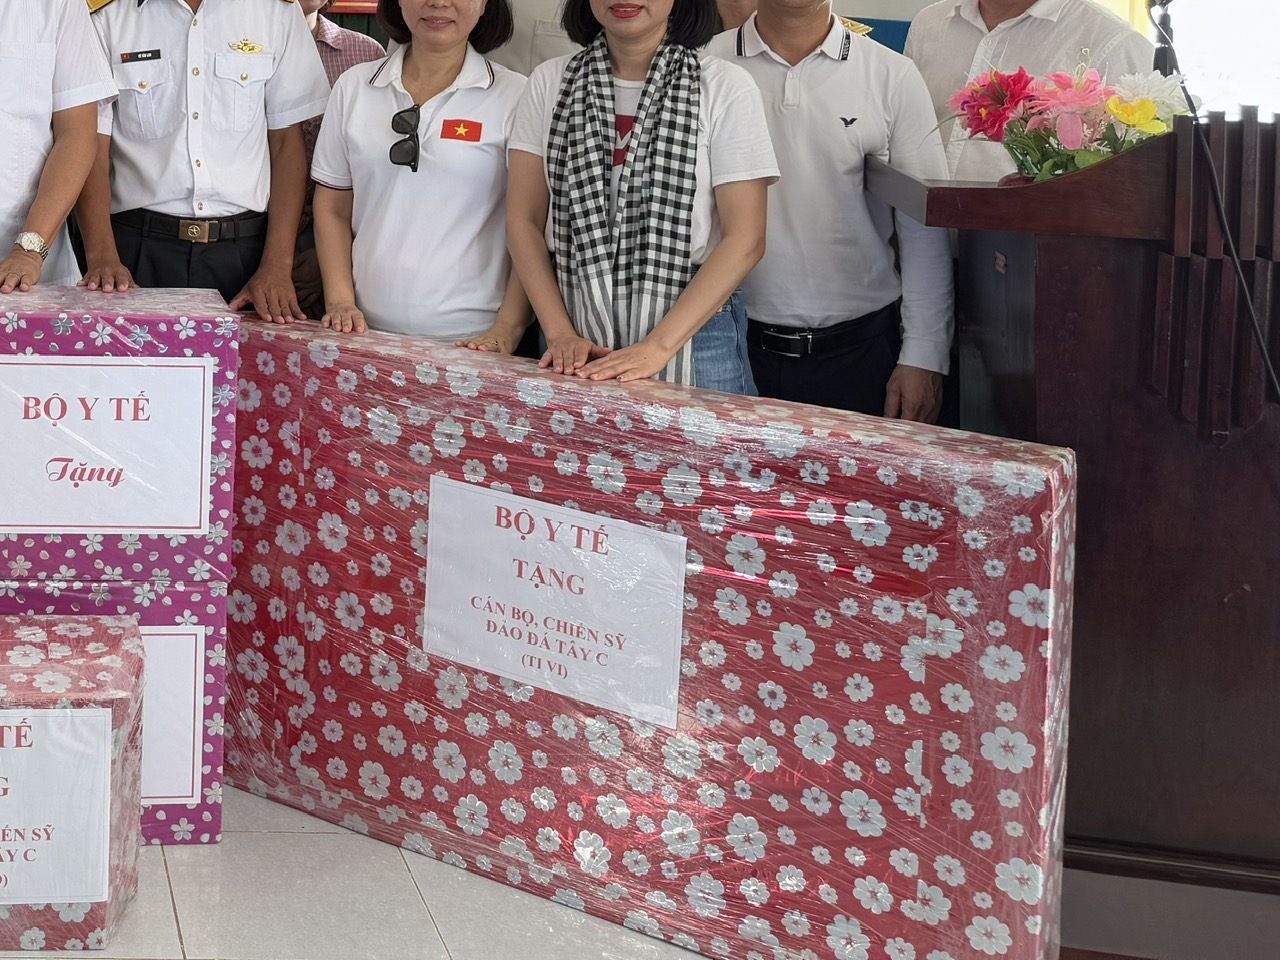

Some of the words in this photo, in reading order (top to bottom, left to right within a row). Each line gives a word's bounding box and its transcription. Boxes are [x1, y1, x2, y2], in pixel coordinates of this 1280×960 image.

[22, 393, 67, 428] BỘ
[78, 397, 103, 422] Y
[108, 389, 151, 422] TẾ
[45, 456, 126, 489] Tặng
[494, 505, 536, 541] BỘ
[543, 517, 565, 543] Y
[570, 524, 610, 557] TẾ
[512, 557, 586, 596] TẶNG
[470, 595, 507, 617] CÁN
[604, 632, 627, 651] SỸ
[486, 618, 523, 642] ĐẢO
[527, 631, 551, 651] ĐÁ
[556, 637, 592, 662] TÂY
[595, 652, 609, 667] C
[521, 653, 543, 670] (TI
[546, 660, 568, 680] VI)
[31, 824, 56, 842] SỸ
[22, 847, 37, 863] C
